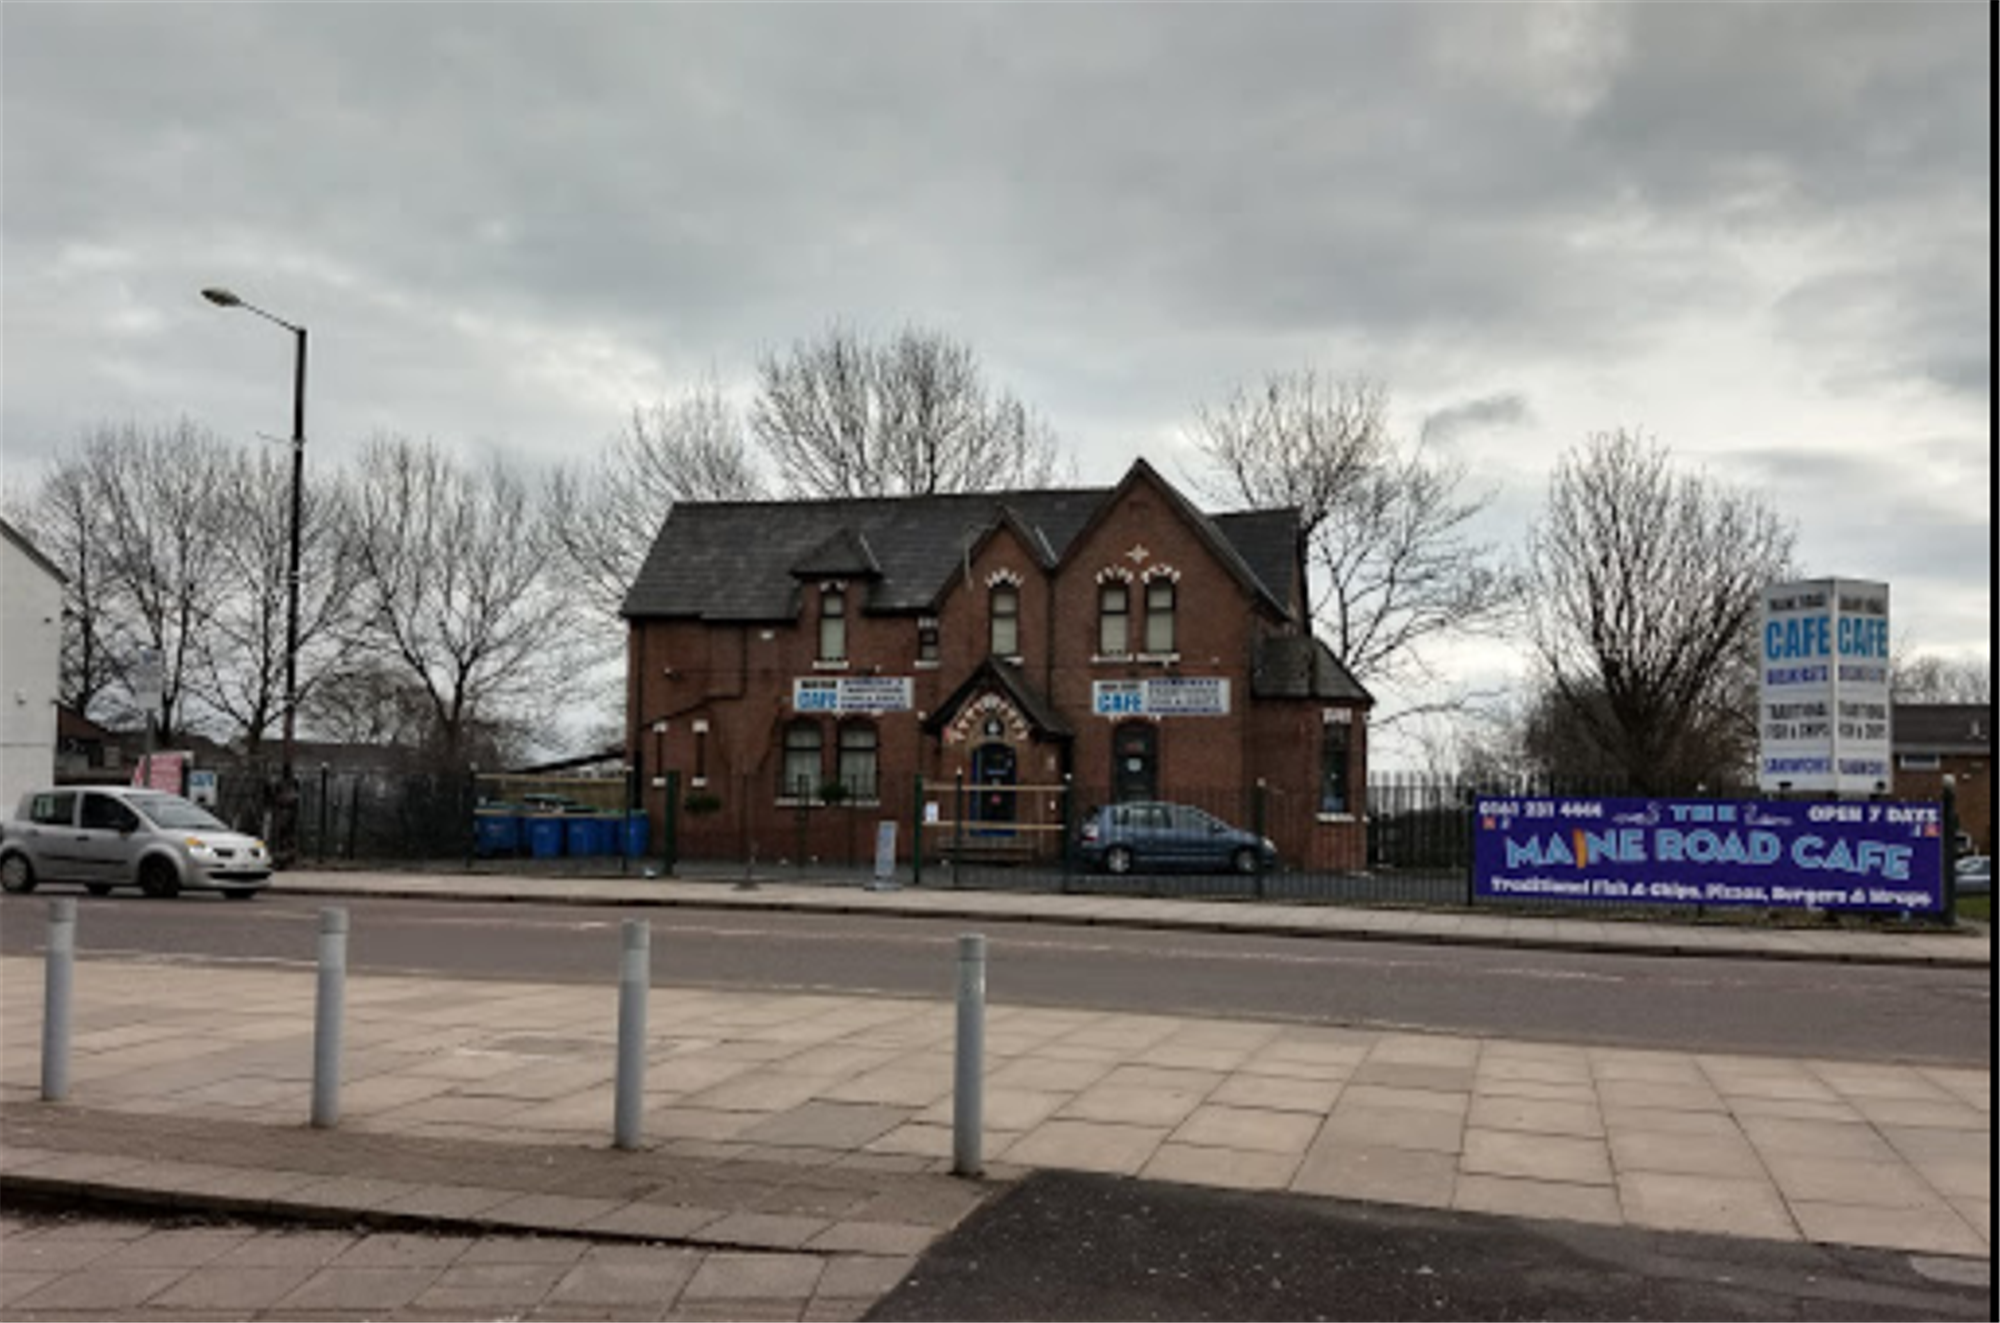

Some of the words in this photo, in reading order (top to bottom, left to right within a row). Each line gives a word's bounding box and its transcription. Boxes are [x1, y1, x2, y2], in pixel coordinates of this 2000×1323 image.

[1766, 615, 1831, 661] CAFE
[1838, 616, 1888, 658] CAFE
[799, 691, 837, 709] CAFE
[1099, 692, 1142, 713] CAFE
[1668, 804, 1737, 822] THE
[1807, 805, 1862, 822] OPEN
[1868, 807, 1881, 822] 7
[1886, 808, 1938, 823] DAYS
[1506, 827, 1647, 869] MAINE
[1655, 828, 1780, 865] ROAD
[1791, 834, 1913, 881] CAFE
[1491, 875, 1590, 895] Traditional
[1592, 879, 1629, 896] Fish
[1631, 882, 1647, 896] &
[1772, 886, 1847, 906] Burgers
[1850, 887, 1866, 904] &
